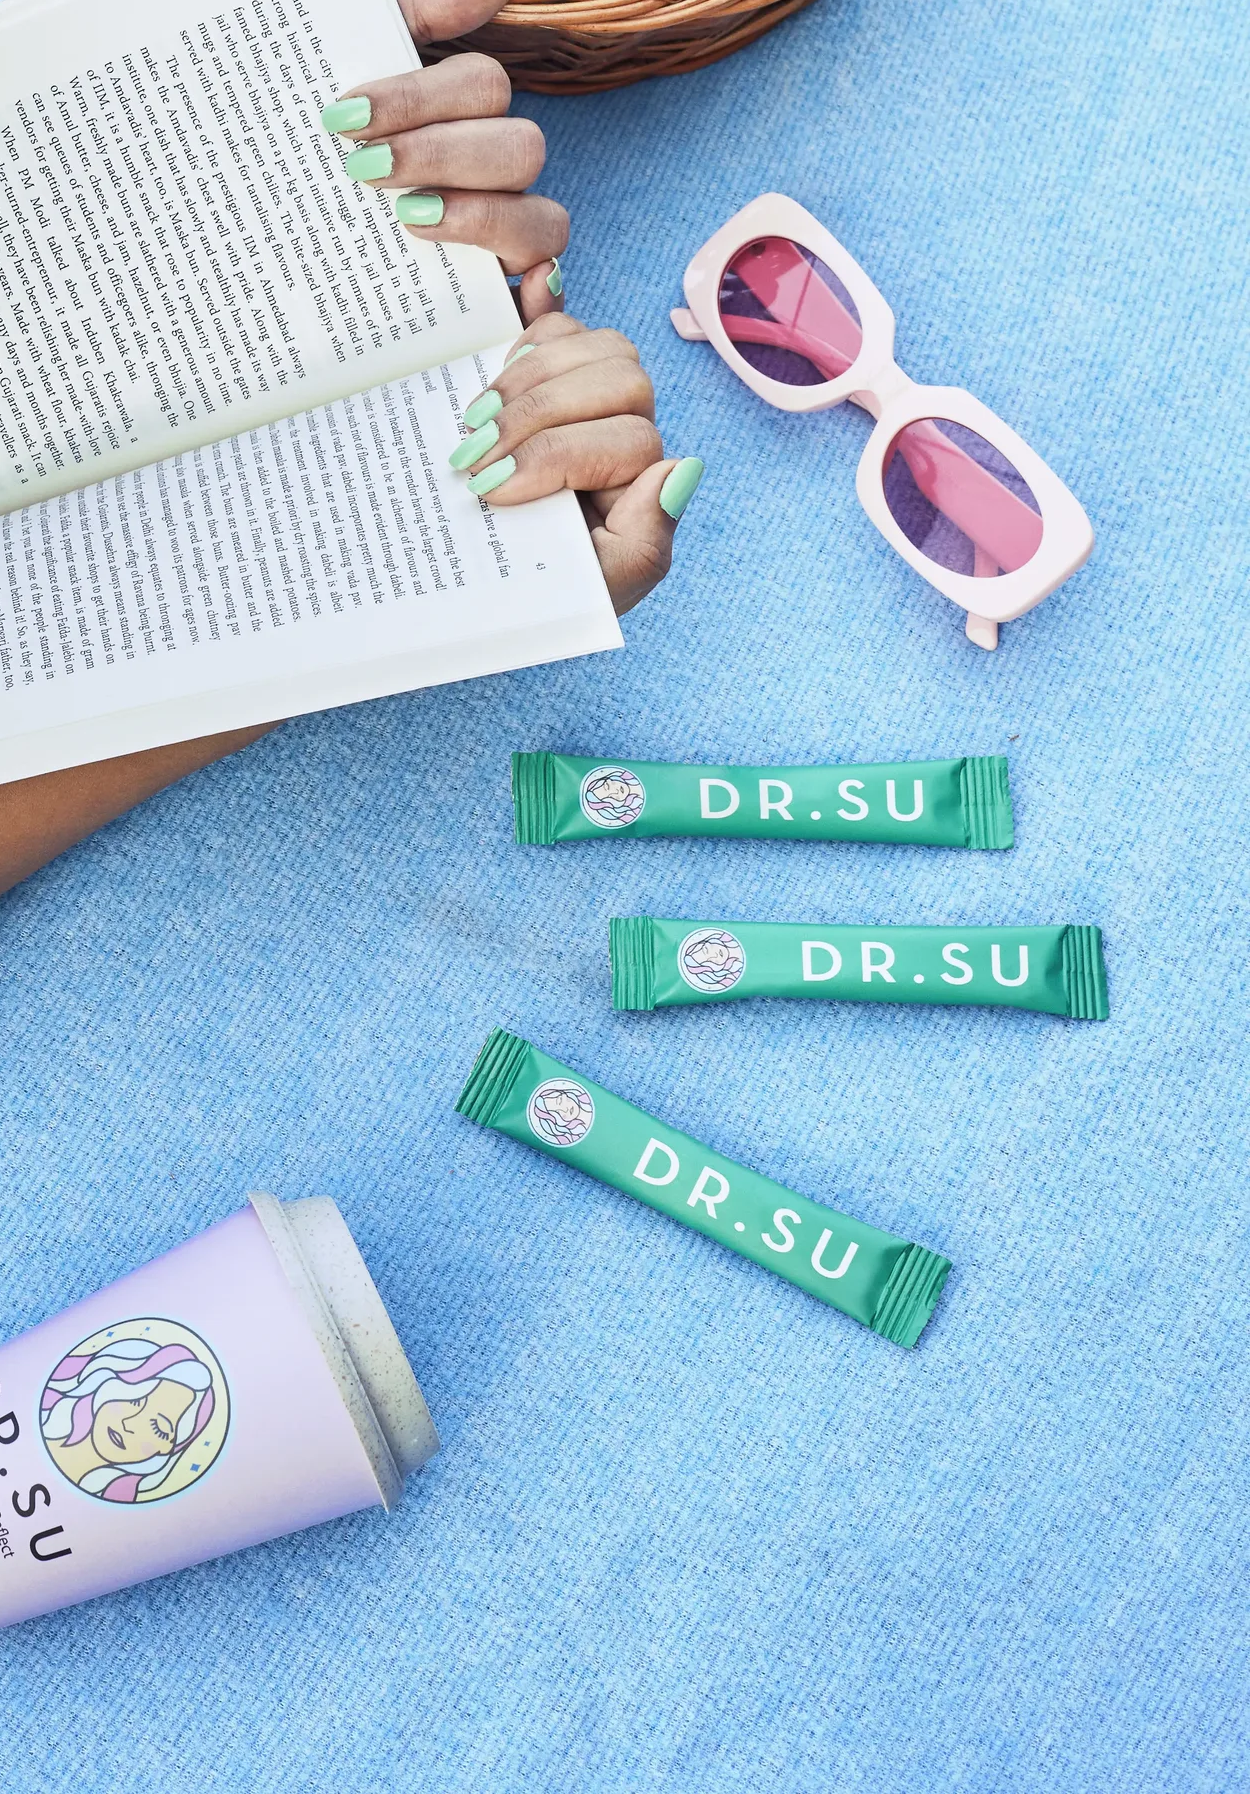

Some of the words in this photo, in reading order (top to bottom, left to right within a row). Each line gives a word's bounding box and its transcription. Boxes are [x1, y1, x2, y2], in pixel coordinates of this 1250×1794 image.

[232, 5, 258, 44] famed
[248, 41, 273, 86] bhajiya
[268, 39, 284, 61] the
[164, 53, 182, 80] The
[278, 62, 297, 91] days
[49, 83, 66, 98] of
[266, 85, 286, 119] shop,
[290, 92, 308, 107] of
[54, 99, 80, 133] Amul
[172, 81, 204, 132] presence
[297, 108, 314, 130] our
[198, 133, 215, 148] of
[281, 117, 304, 155] which
[70, 131, 93, 174] butter,
[204, 148, 220, 170] the
[295, 153, 309, 167] is
[308, 132, 336, 182] freedom
[301, 166, 315, 183] an
[87, 173, 111, 216] cheese,
[210, 170, 248, 234] prestigious
[308, 181, 337, 235] initiative
[330, 183, 358, 234] struggle.
[105, 215, 126, 240] and
[111, 238, 132, 268] jam,
[241, 233, 262, 260] IIM
[330, 234, 347, 258] run
[352, 233, 370, 260] The
[252, 259, 265, 276] in
[339, 255, 354, 272] by
[359, 261, 382, 282] jail
[0, 123, 21, 163] When
[16, 166, 37, 192] PM
[28, 195, 53, 231] Modi
[45, 234, 71, 272] talked
[63, 277, 86, 312] about
[79, 315, 107, 366] Induben
[101, 369, 135, 434] Khakrawala,
[129, 435, 140, 445] a
[126, 265, 156, 321] hazelnut,
[446, 267, 463, 295] With
[346, 272, 372, 319] inmates
[371, 281, 395, 323] houses
[454, 292, 472, 315] Soul
[53, 305, 67, 318] it
[258, 278, 297, 345] Ahmedabad
[364, 318, 381, 332] of
[59, 318, 81, 352] made
[149, 320, 163, 335] or
[369, 330, 384, 350] the
[388, 323, 403, 343] the
[73, 352, 90, 369] all
[155, 335, 174, 364] even
[286, 345, 308, 380] always
[81, 369, 109, 420] Gujaratis
[167, 361, 189, 401] bhujia.
[400, 387, 415, 397] of
[182, 399, 198, 422] One
[402, 394, 417, 408] the
[100, 419, 122, 451] rejoice
[405, 406, 428, 452] commonest
[418, 450, 435, 468] and
[132, 480, 147, 492] for
[422, 467, 440, 495] easiest
[130, 489, 150, 512] people
[137, 507, 151, 519] in
[429, 493, 445, 515] ways
[139, 516, 156, 539] Delhi
[435, 513, 452, 524] of
[481, 511, 497, 533] have
[435, 523, 457, 558] spotting
[487, 531, 499, 540] a
[143, 536, 158, 564] always
[447, 555, 463, 571] the
[486, 538, 510, 565] global
[146, 561, 165, 593] equates
[451, 569, 467, 589] best
[497, 563, 512, 580] fan
[534, 561, 548, 572] 43
[154, 591, 167, 603] to
[157, 601, 176, 644] thronging
[165, 641, 178, 653] at
[699, 778, 925, 822] DR.SU
[801, 940, 1030, 987] DR.SU
[631, 1137, 860, 1279] DR.SU
